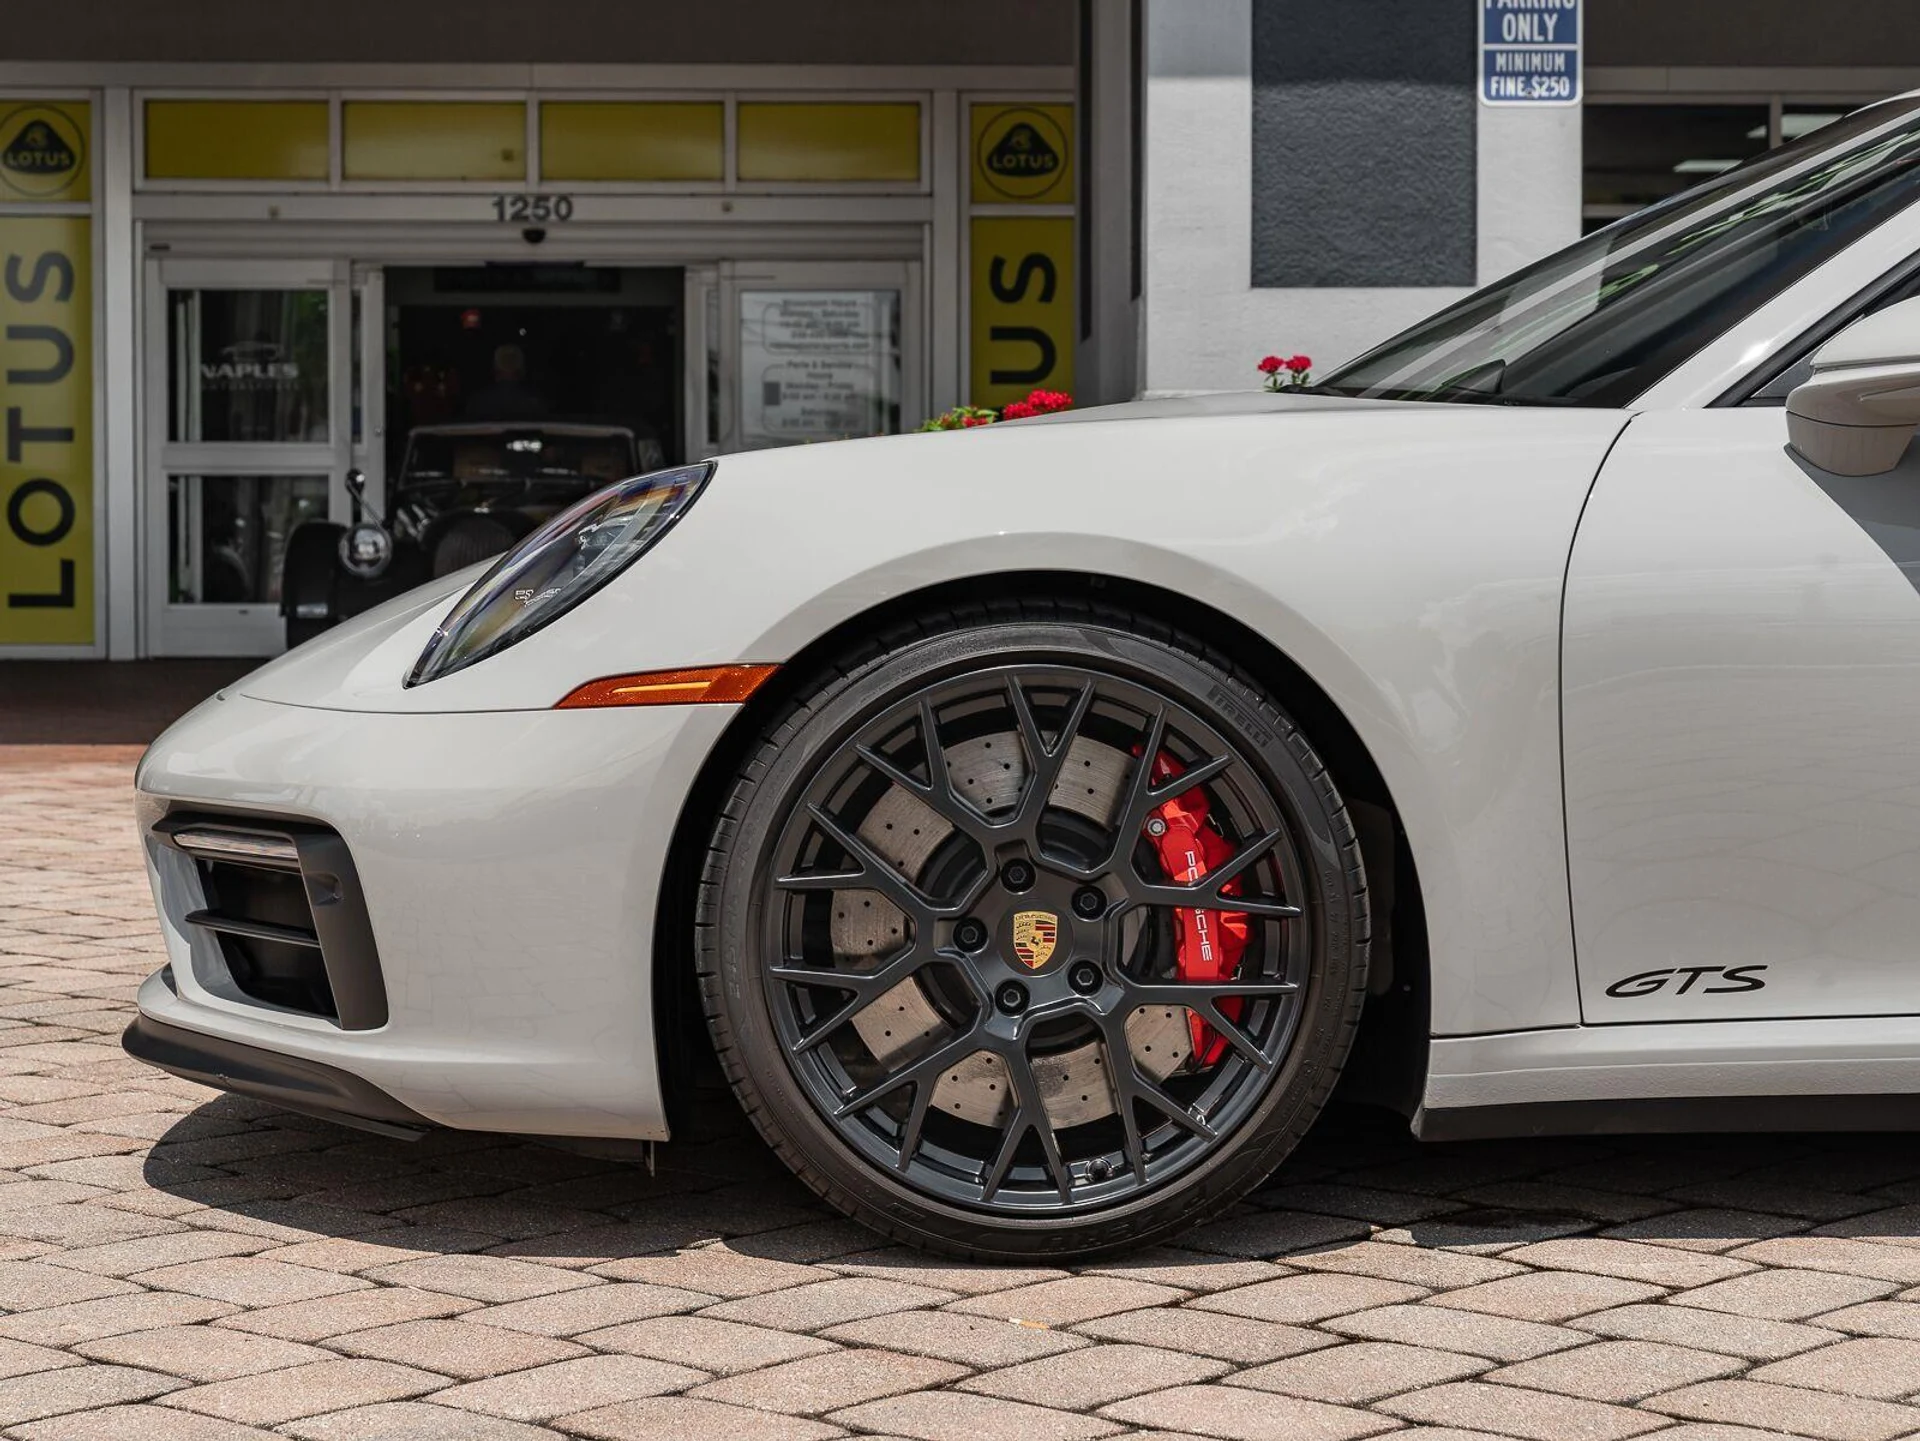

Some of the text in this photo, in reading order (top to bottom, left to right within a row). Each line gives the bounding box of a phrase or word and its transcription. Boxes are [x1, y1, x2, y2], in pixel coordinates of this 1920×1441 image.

[1502, 12, 1558, 42] ONLY
[1495, 52, 1565, 73] MINIMUM
[1490, 75, 1570, 99] FINE $250
[6, 151, 71, 168] LOTUS
[992, 153, 1053, 169] LOTUS
[492, 195, 573, 222] 1250
[201, 362, 299, 379] NAPLES
[5, 250, 76, 609] LOTUS
[1205, 684, 1275, 747] PIRELLI
[1184, 850, 1213, 962] POCHE
[1605, 965, 1768, 998] GTS
